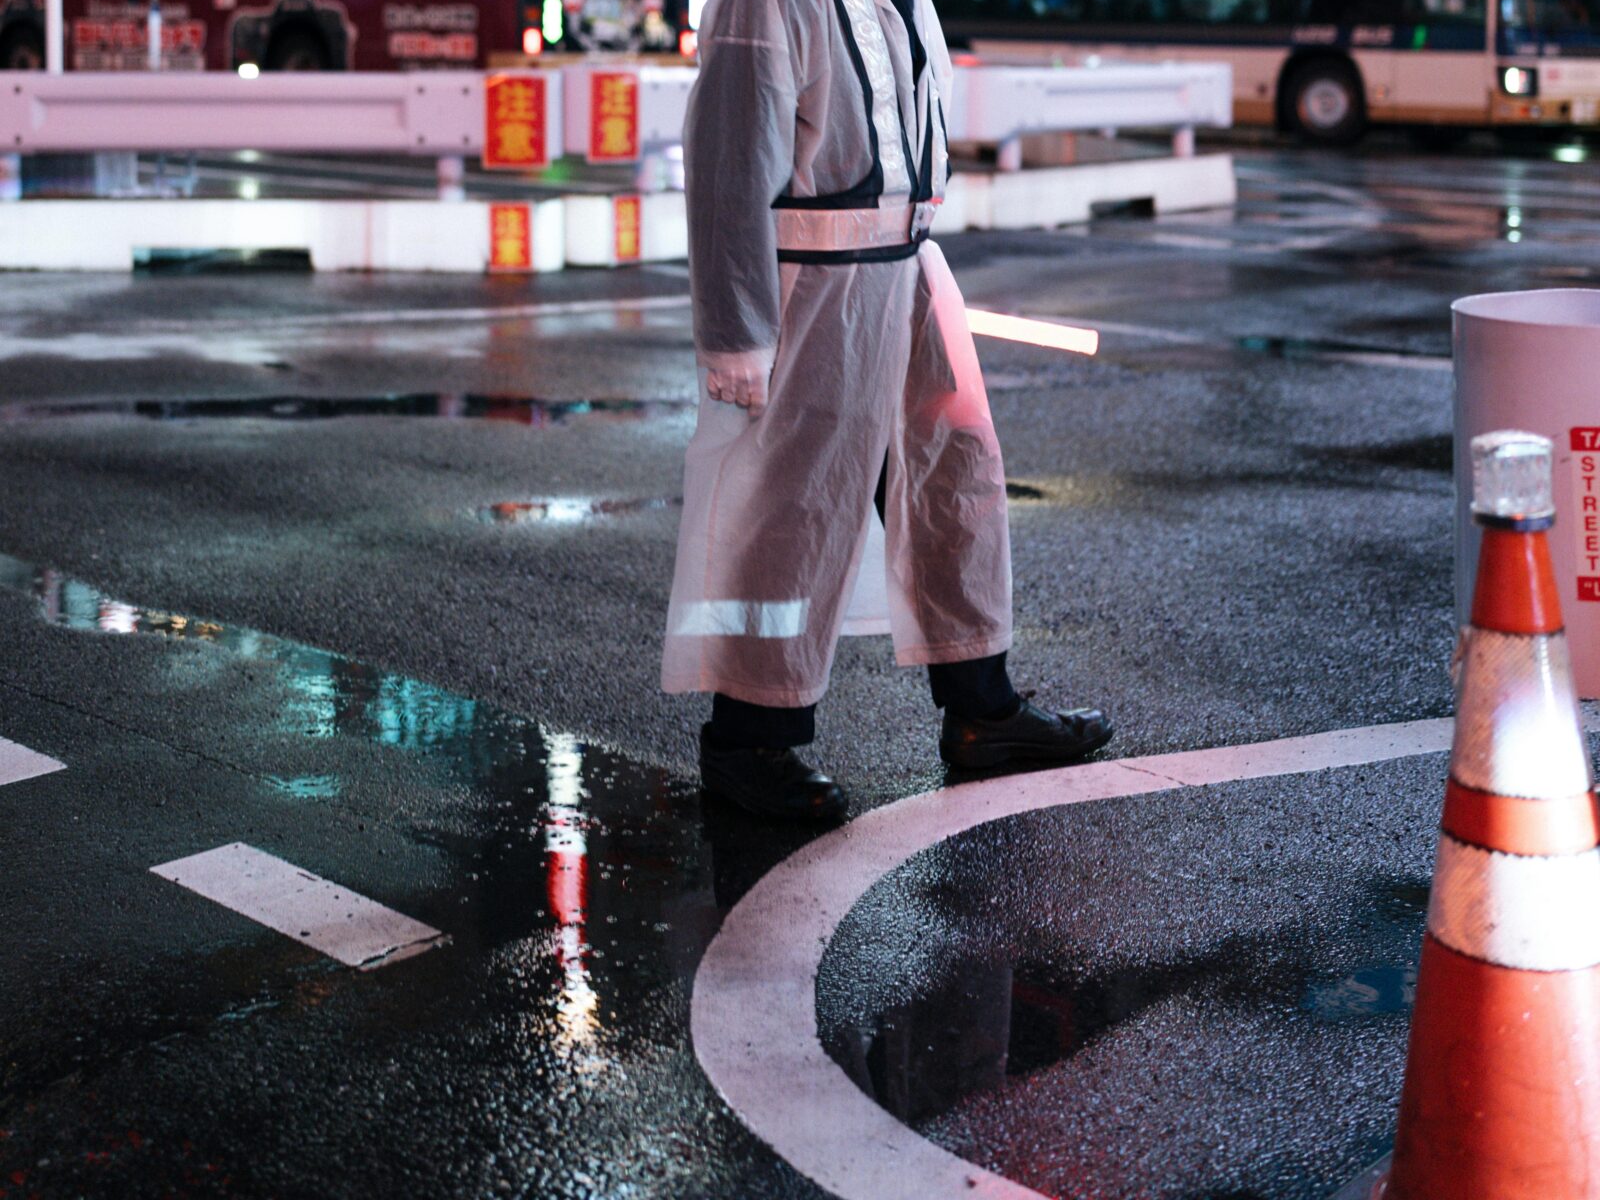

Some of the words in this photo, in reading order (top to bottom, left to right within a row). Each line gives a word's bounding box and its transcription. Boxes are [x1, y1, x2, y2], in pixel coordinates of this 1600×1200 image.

[496, 81, 538, 161] 注意
[600, 79, 632, 155] 注意
[1581, 455, 1599, 572] STREET
